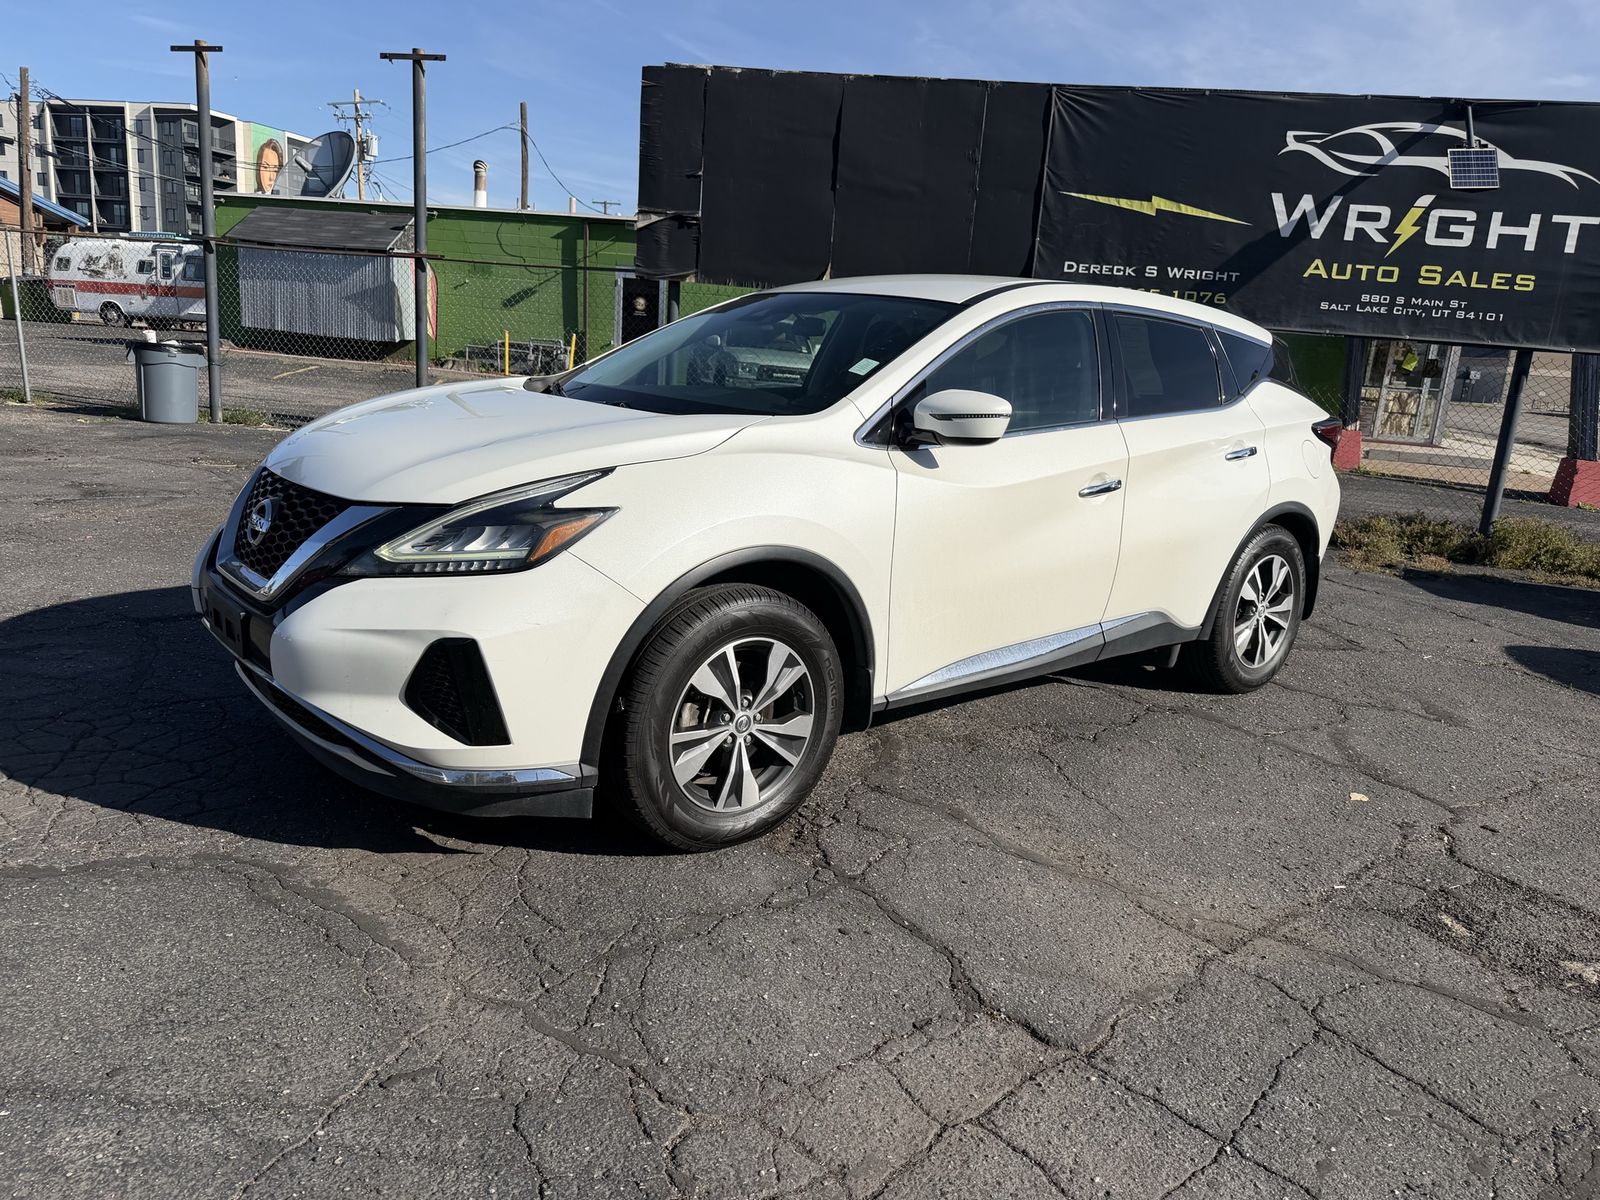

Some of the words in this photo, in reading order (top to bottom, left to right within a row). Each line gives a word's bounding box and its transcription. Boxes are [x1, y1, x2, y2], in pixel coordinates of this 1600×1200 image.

[1144, 265, 1158, 278] S
[1361, 294, 1390, 304] 880
[1396, 296, 1405, 305] S
[1432, 309, 1451, 318] UT
[1456, 311, 1504, 321] 84101
